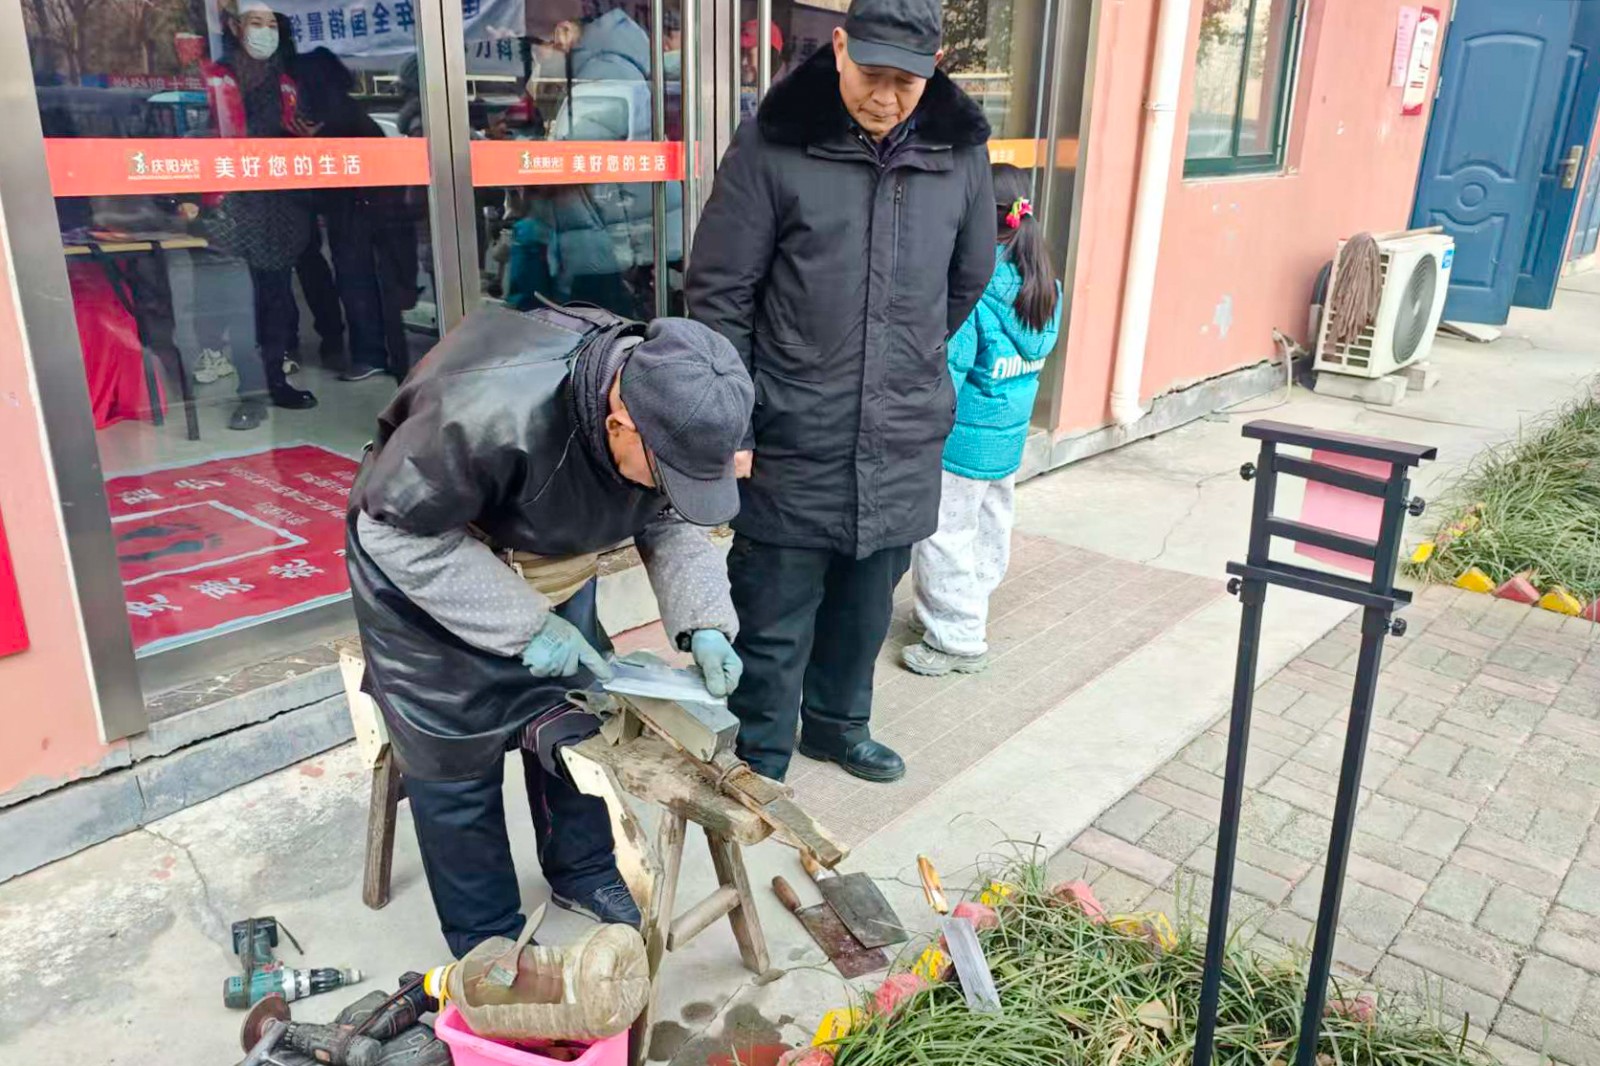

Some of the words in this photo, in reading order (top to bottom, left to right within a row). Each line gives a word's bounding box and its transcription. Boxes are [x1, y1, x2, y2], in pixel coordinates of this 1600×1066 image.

[214, 155, 361, 178] 美好您的生活
[572, 155, 666, 173] 美好您的生活
